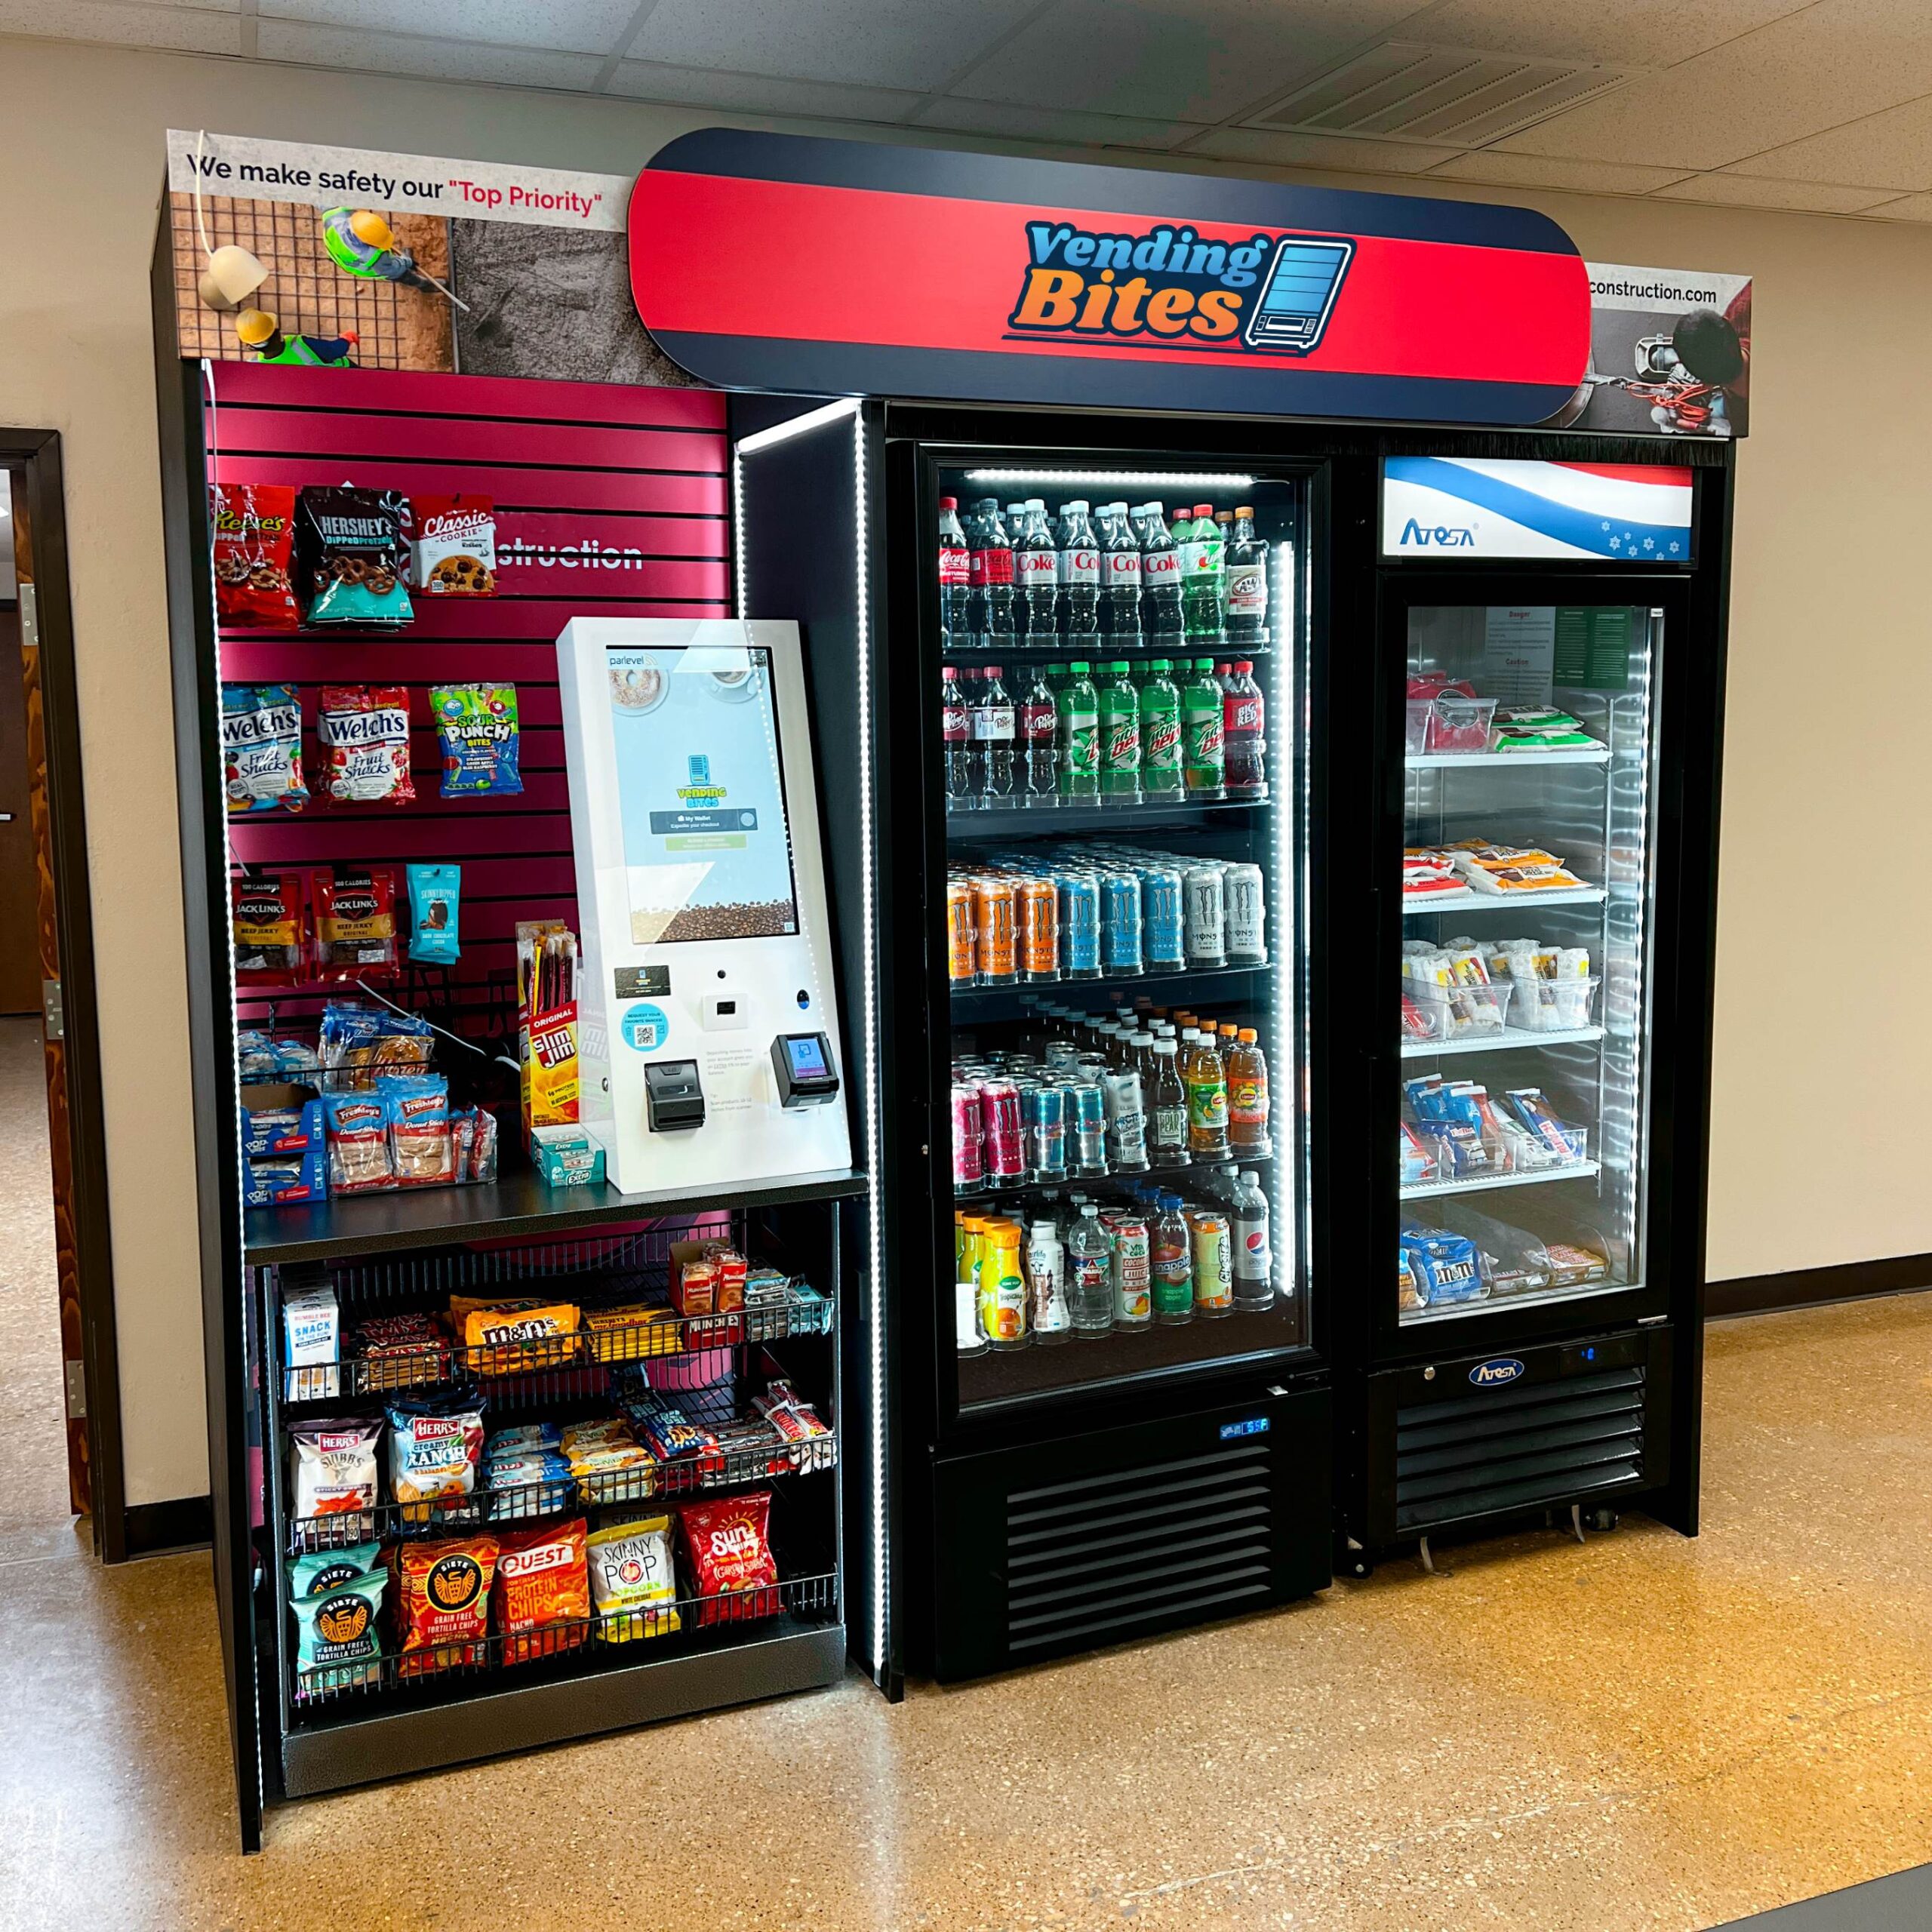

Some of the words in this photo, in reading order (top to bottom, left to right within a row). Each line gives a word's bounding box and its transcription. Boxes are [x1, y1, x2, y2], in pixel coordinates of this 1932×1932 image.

[187, 153, 232, 179] We
[240, 159, 311, 189] make
[318, 170, 395, 199] safety
[402, 180, 444, 199] our
[449, 180, 503, 208] "Top
[509, 186, 602, 217] Priority"
[1031, 226, 1269, 288] Vending
[1589, 281, 1717, 303] construction.com
[1014, 269, 1244, 337] Bites
[320, 515, 393, 536] HERSHEY'S
[423, 510, 494, 537] Classic
[440, 528, 478, 543] COOKIE
[1019, 554, 1055, 571] Coke
[609, 655, 644, 666] parlevel
[1238, 702, 1254, 717] BIG
[223, 712, 297, 742] Welch's
[328, 713, 405, 741] Welch's
[457, 714, 496, 727] SOUR
[1237, 712, 1258, 727] RED
[445, 724, 511, 742] PUNCH
[241, 760, 289, 778] Snacks
[353, 754, 384, 768] Fruit
[345, 762, 391, 780] Snacks
[235, 905, 259, 914] JACK
[329, 901, 352, 910] JACK
[534, 1008, 573, 1029] ORIGINAL
[533, 1029, 571, 1054] slim
[544, 1041, 576, 1068] jim
[405, 1096, 445, 1112] Freshley's
[405, 1121, 427, 1130] Donut
[1159, 1114, 1180, 1122] GOLD
[1159, 1122, 1180, 1132] PEAK
[294, 1321, 331, 1337] SNACK
[418, 1422, 455, 1436] HERR'S
[322, 1435, 355, 1448] HERR'S
[413, 1440, 450, 1451] creamy
[320, 1453, 365, 1469] STUBB'S
[408, 1445, 466, 1466] RANCH
[710, 1526, 748, 1556] Sun
[604, 1537, 652, 1564] SKINNY
[441, 1560, 469, 1572] SIETE
[501, 1546, 566, 1574] QUEST
[321, 1569, 352, 1583] SIETE
[604, 1555, 657, 1589] POP
[506, 1576, 558, 1602] PROTEIN
[612, 1581, 661, 1598] POPCORN
[327, 1598, 358, 1612] SIETE
[508, 1593, 553, 1620] CHIPS
[434, 1614, 454, 1624] GRAIN
[456, 1611, 472, 1621] FREE
[509, 1619, 534, 1631] NACHO
[427, 1623, 457, 1634] TORTILLA
[459, 1620, 478, 1629] CHIPS
[324, 1644, 346, 1653] GRAIN
[347, 1641, 365, 1650] FREE
[431, 1633, 469, 1645] NACHO
[317, 1651, 348, 1662] TORTILLA
[350, 1646, 371, 1656] CHIPS
